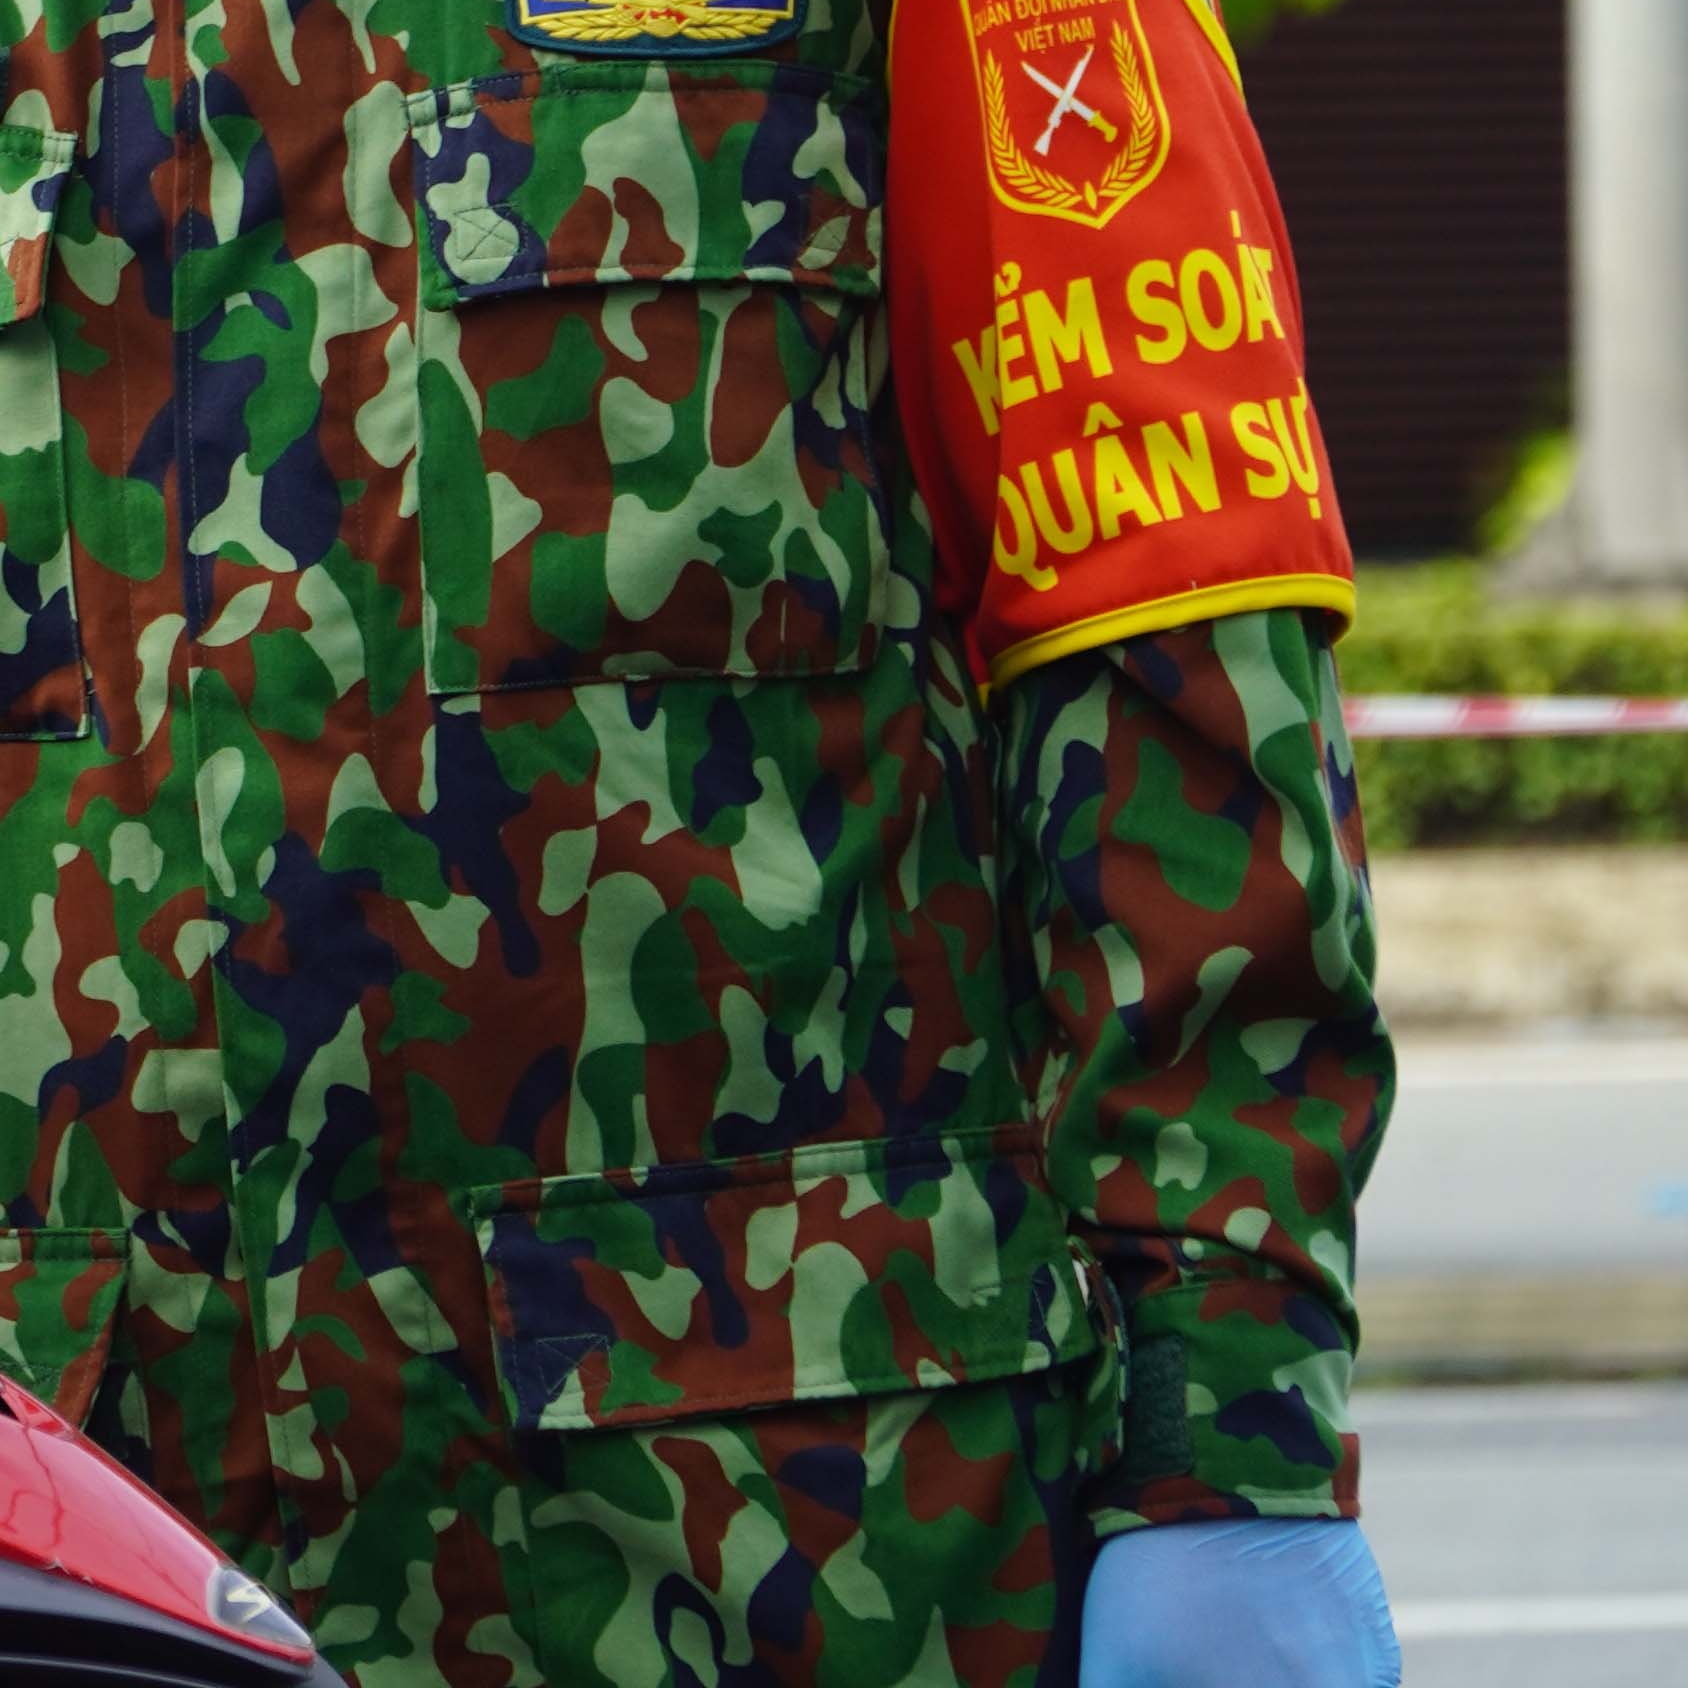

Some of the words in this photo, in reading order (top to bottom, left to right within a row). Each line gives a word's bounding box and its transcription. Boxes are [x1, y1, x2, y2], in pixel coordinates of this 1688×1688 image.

[1014, 23, 1055, 54] VIỆT
[1058, 15, 1096, 44] NAM
[993, 402, 1222, 592] QUÂN
